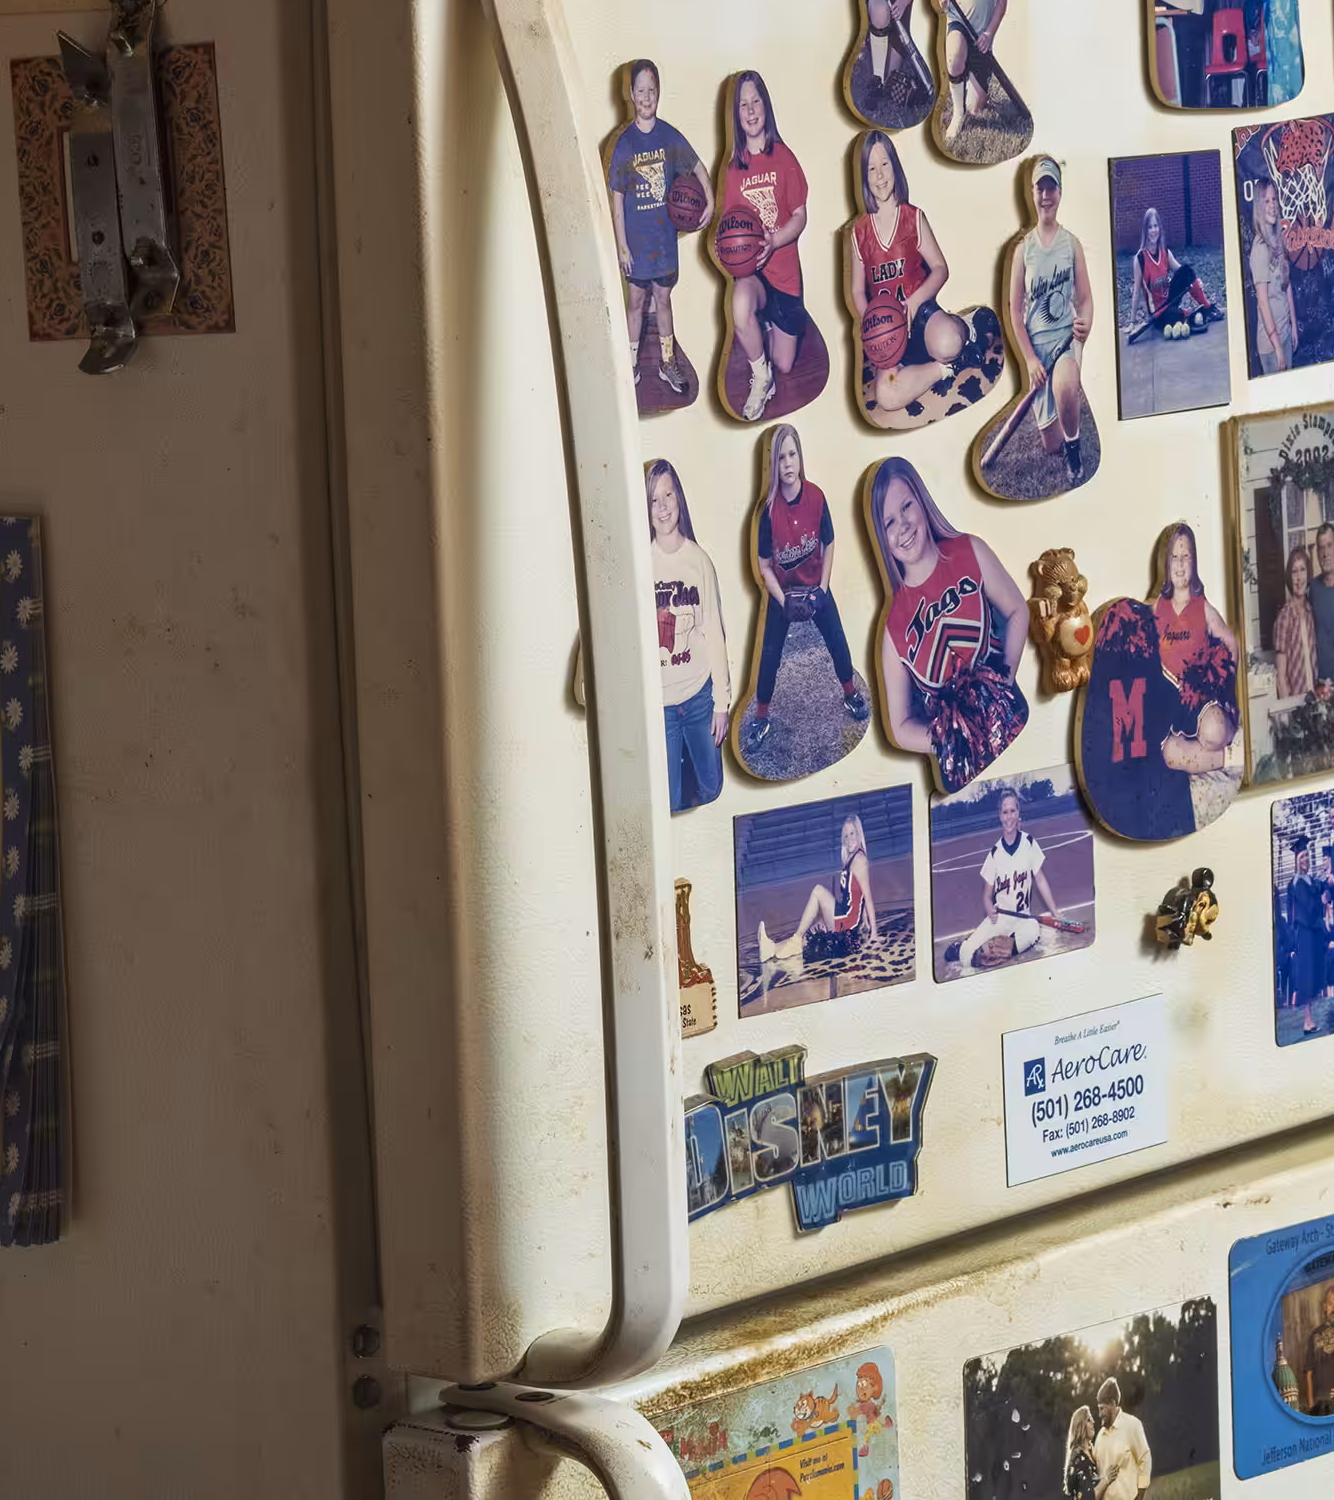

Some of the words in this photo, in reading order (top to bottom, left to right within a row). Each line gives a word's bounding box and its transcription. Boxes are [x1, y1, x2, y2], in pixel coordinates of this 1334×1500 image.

[633, 148, 666, 168] JAGUAR
[672, 191, 701, 208] Wilson
[739, 171, 777, 192] JAGUAR
[871, 258, 905, 284] LADY
[905, 576, 978, 665] Jags
[1109, 677, 1147, 763] M
[1054, 1032, 1076, 1045] Breathe
[1077, 1030, 1083, 1040] A
[1083, 1027, 1098, 1038] Little
[714, 1053, 803, 1107] WALT
[1032, 1094, 1069, 1128] (501)
[1073, 1074, 1144, 1112] 268-4500
[684, 1060, 925, 1214] DISNEY
[1043, 1128, 1063, 1143] Fax:
[1066, 1118, 1089, 1139] (501)
[1091, 1106, 1135, 1130] 268-8902
[1051, 1129, 1128, 1158] www.aerocareusa.com
[797, 1160, 910, 1224] WORLD
[1266, 1236, 1300, 1256] Gateway
[1301, 1228, 1319, 1245] Arch
[1261, 1443, 1298, 1466] Jefferson
[1299, 1430, 1333, 1452] National
